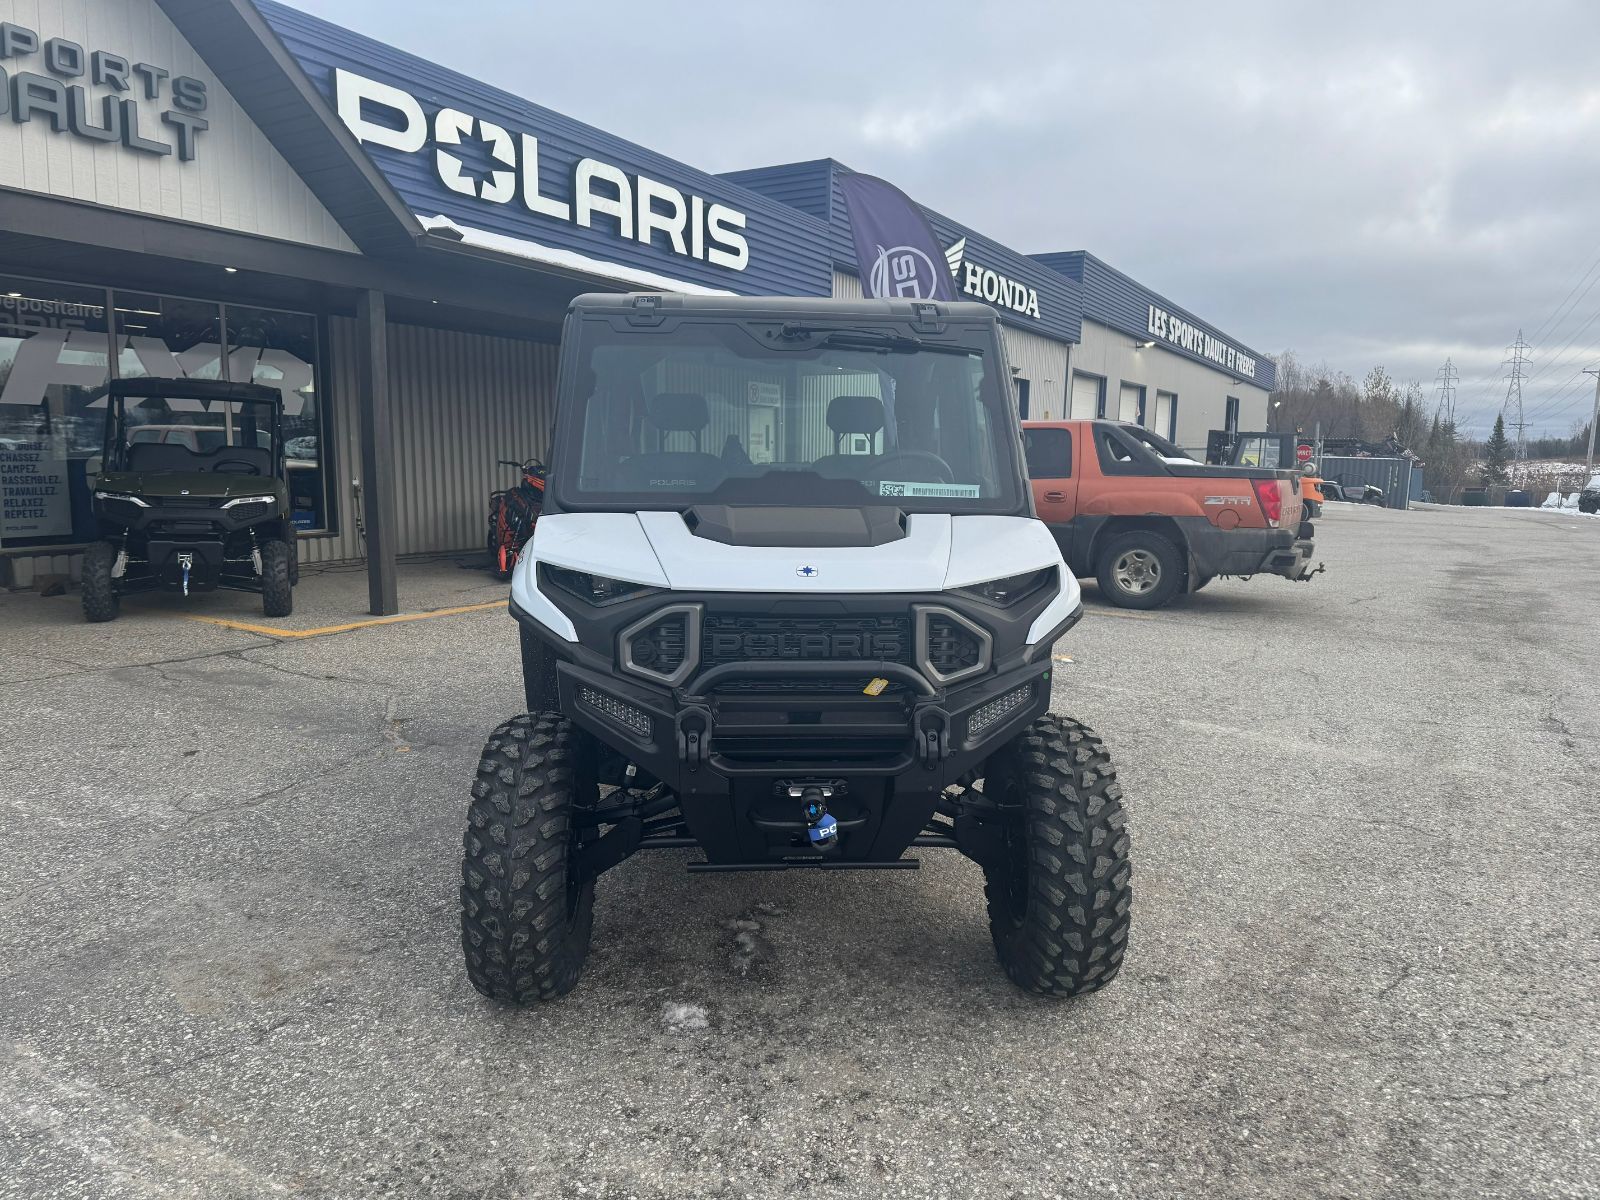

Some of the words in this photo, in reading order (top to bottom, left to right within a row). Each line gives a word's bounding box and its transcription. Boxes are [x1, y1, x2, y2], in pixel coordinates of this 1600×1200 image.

[0, 65, 208, 161] AULT
[335, 67, 750, 272] POLARIS
[963, 261, 1041, 319] HONDA
[1147, 304, 1167, 339] LES
[1168, 316, 1203, 355] SPORTS
[1204, 334, 1227, 366] DAULT
[1227, 347, 1236, 369] ET
[1, 464, 40, 474] CAMPEZ.
[2, 475, 63, 485] RASSEMBLEZ.
[2, 486, 59, 497] TRAVAILLEZ.
[649, 479, 697, 487] POLARIS
[711, 633, 902, 658] POLARIS
